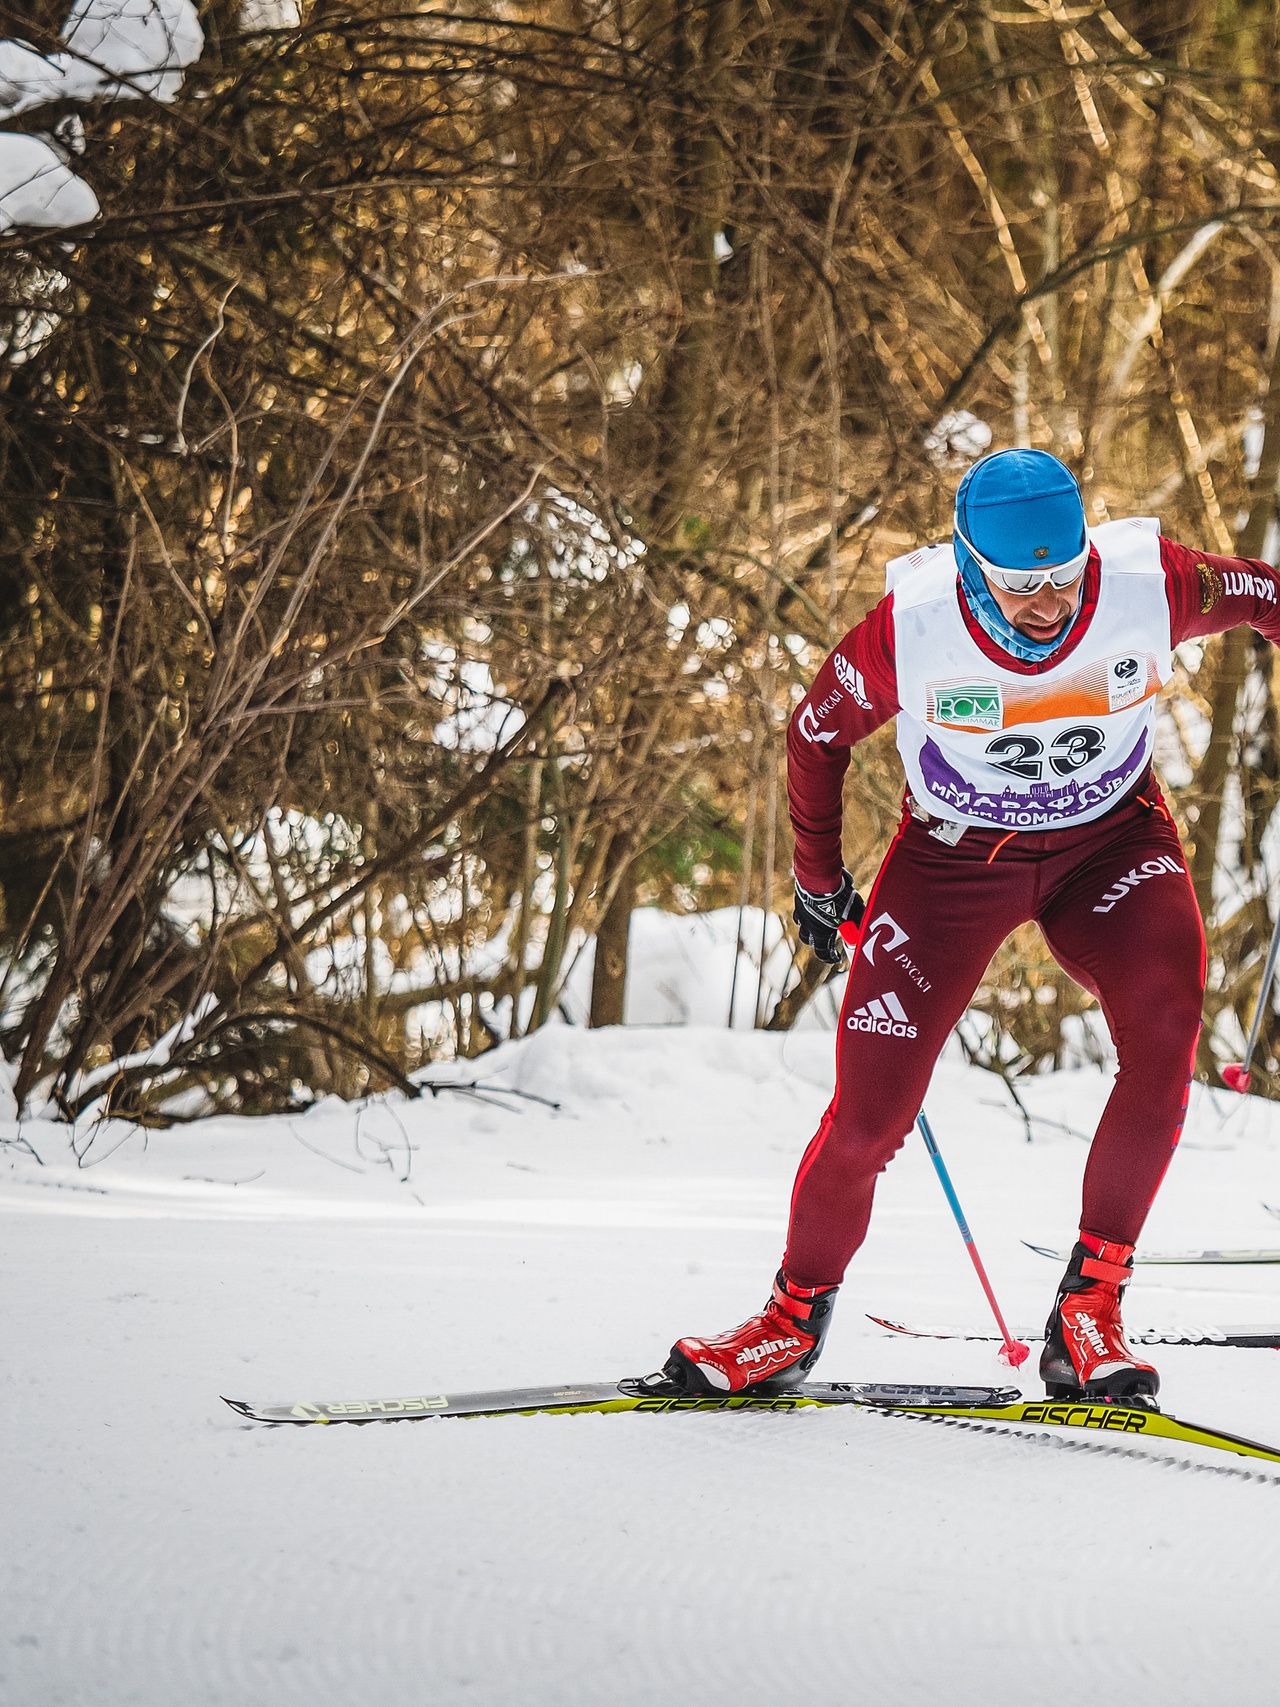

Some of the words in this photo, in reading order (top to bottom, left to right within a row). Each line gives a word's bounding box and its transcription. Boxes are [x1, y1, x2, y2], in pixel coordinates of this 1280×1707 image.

[834, 653, 873, 710] adidas
[816, 689, 844, 719] РУСАЛ
[985, 725, 1106, 780] 23
[1093, 855, 1186, 913] LUKOIL
[895, 953, 932, 993] РУСАЛ
[847, 1016, 918, 1039] adidas
[736, 1336, 801, 1365] alpina
[1075, 1312, 1110, 1357] alpina
[327, 1396, 449, 1414] FISCHER
[1020, 1406, 1147, 1433] FISCHER
